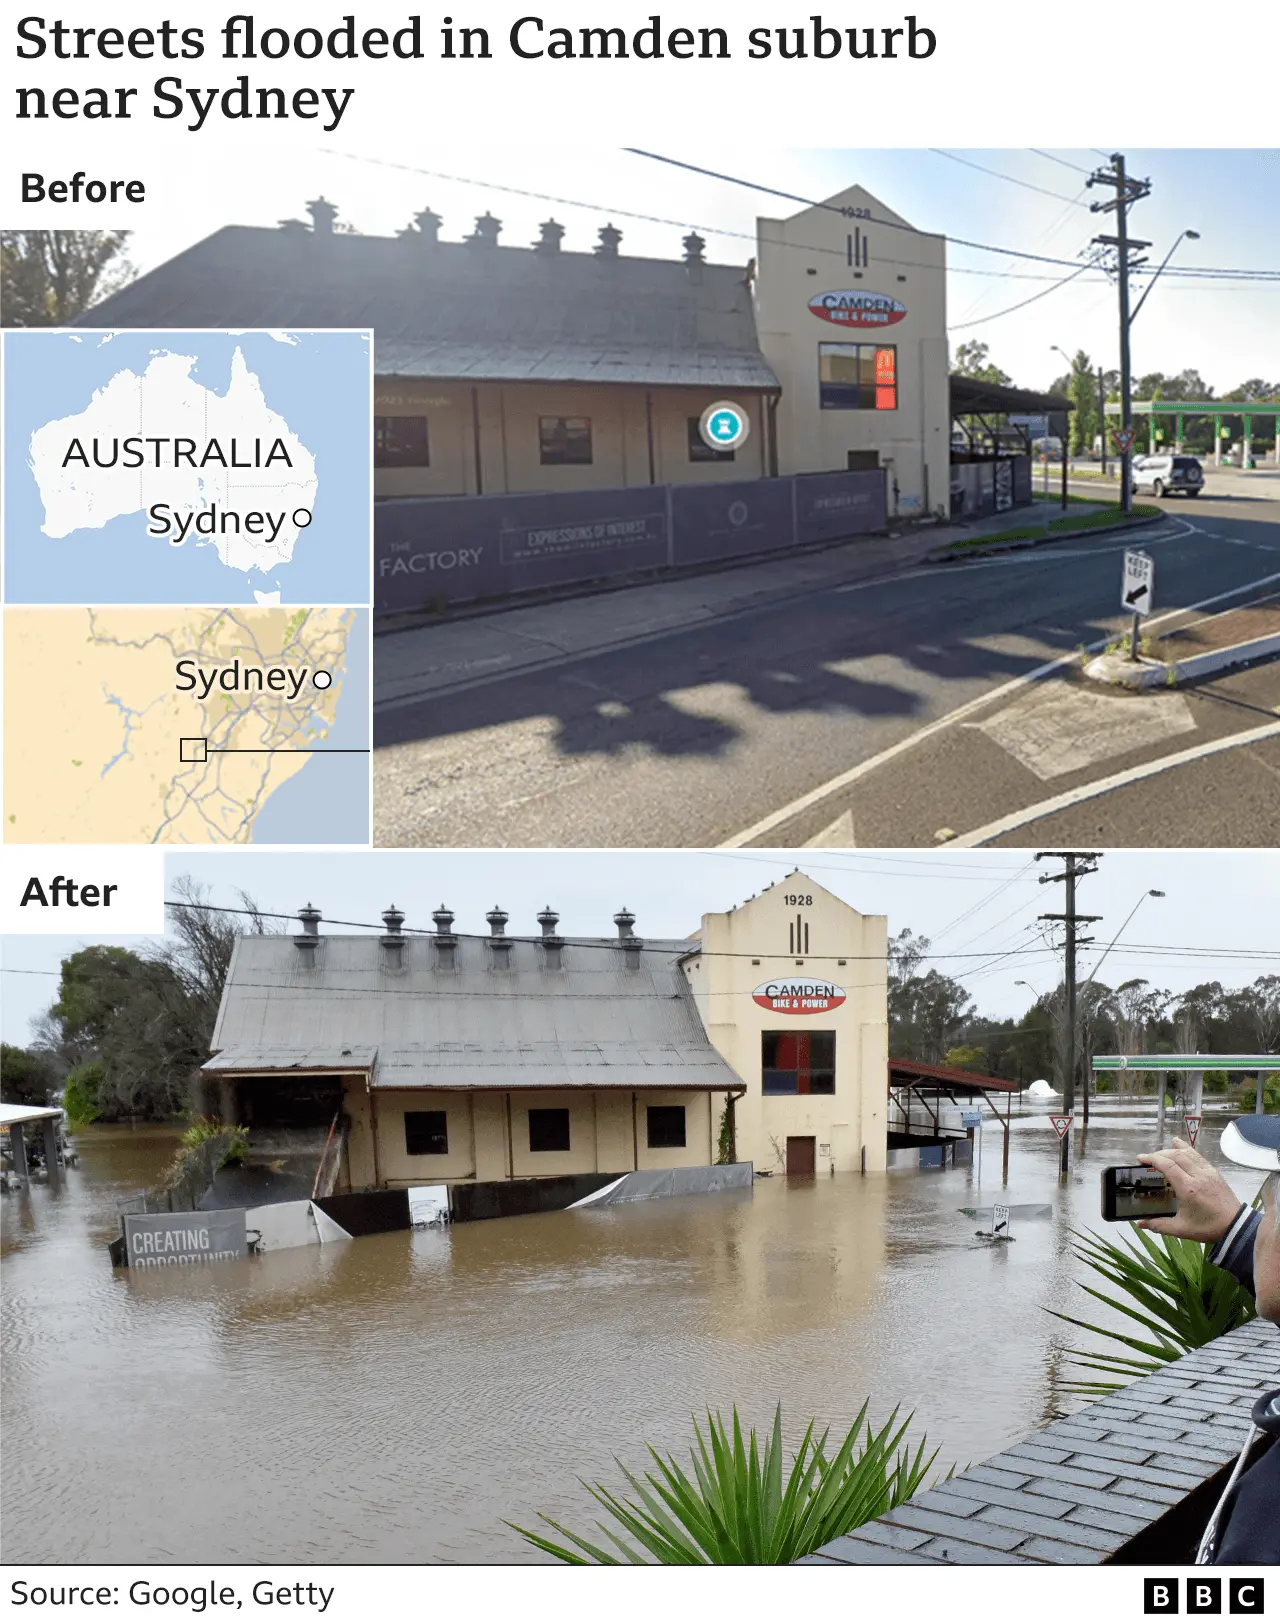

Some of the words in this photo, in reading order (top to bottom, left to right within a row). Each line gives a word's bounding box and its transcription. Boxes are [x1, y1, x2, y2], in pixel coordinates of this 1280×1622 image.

[822, 295, 894, 313] CAMDEN
[380, 547, 483, 576] FACTORY
[1128, 557, 1149, 569] KEEP
[1128, 566, 1148, 581] LEFT
[784, 895, 813, 906] 1928
[765, 985, 834, 999] CAMDEN
[773, 999, 790, 1008] BIKE
[793, 999, 799, 1008] &
[801, 999, 828, 1008] POWER
[132, 1229, 210, 1254] CREATING
